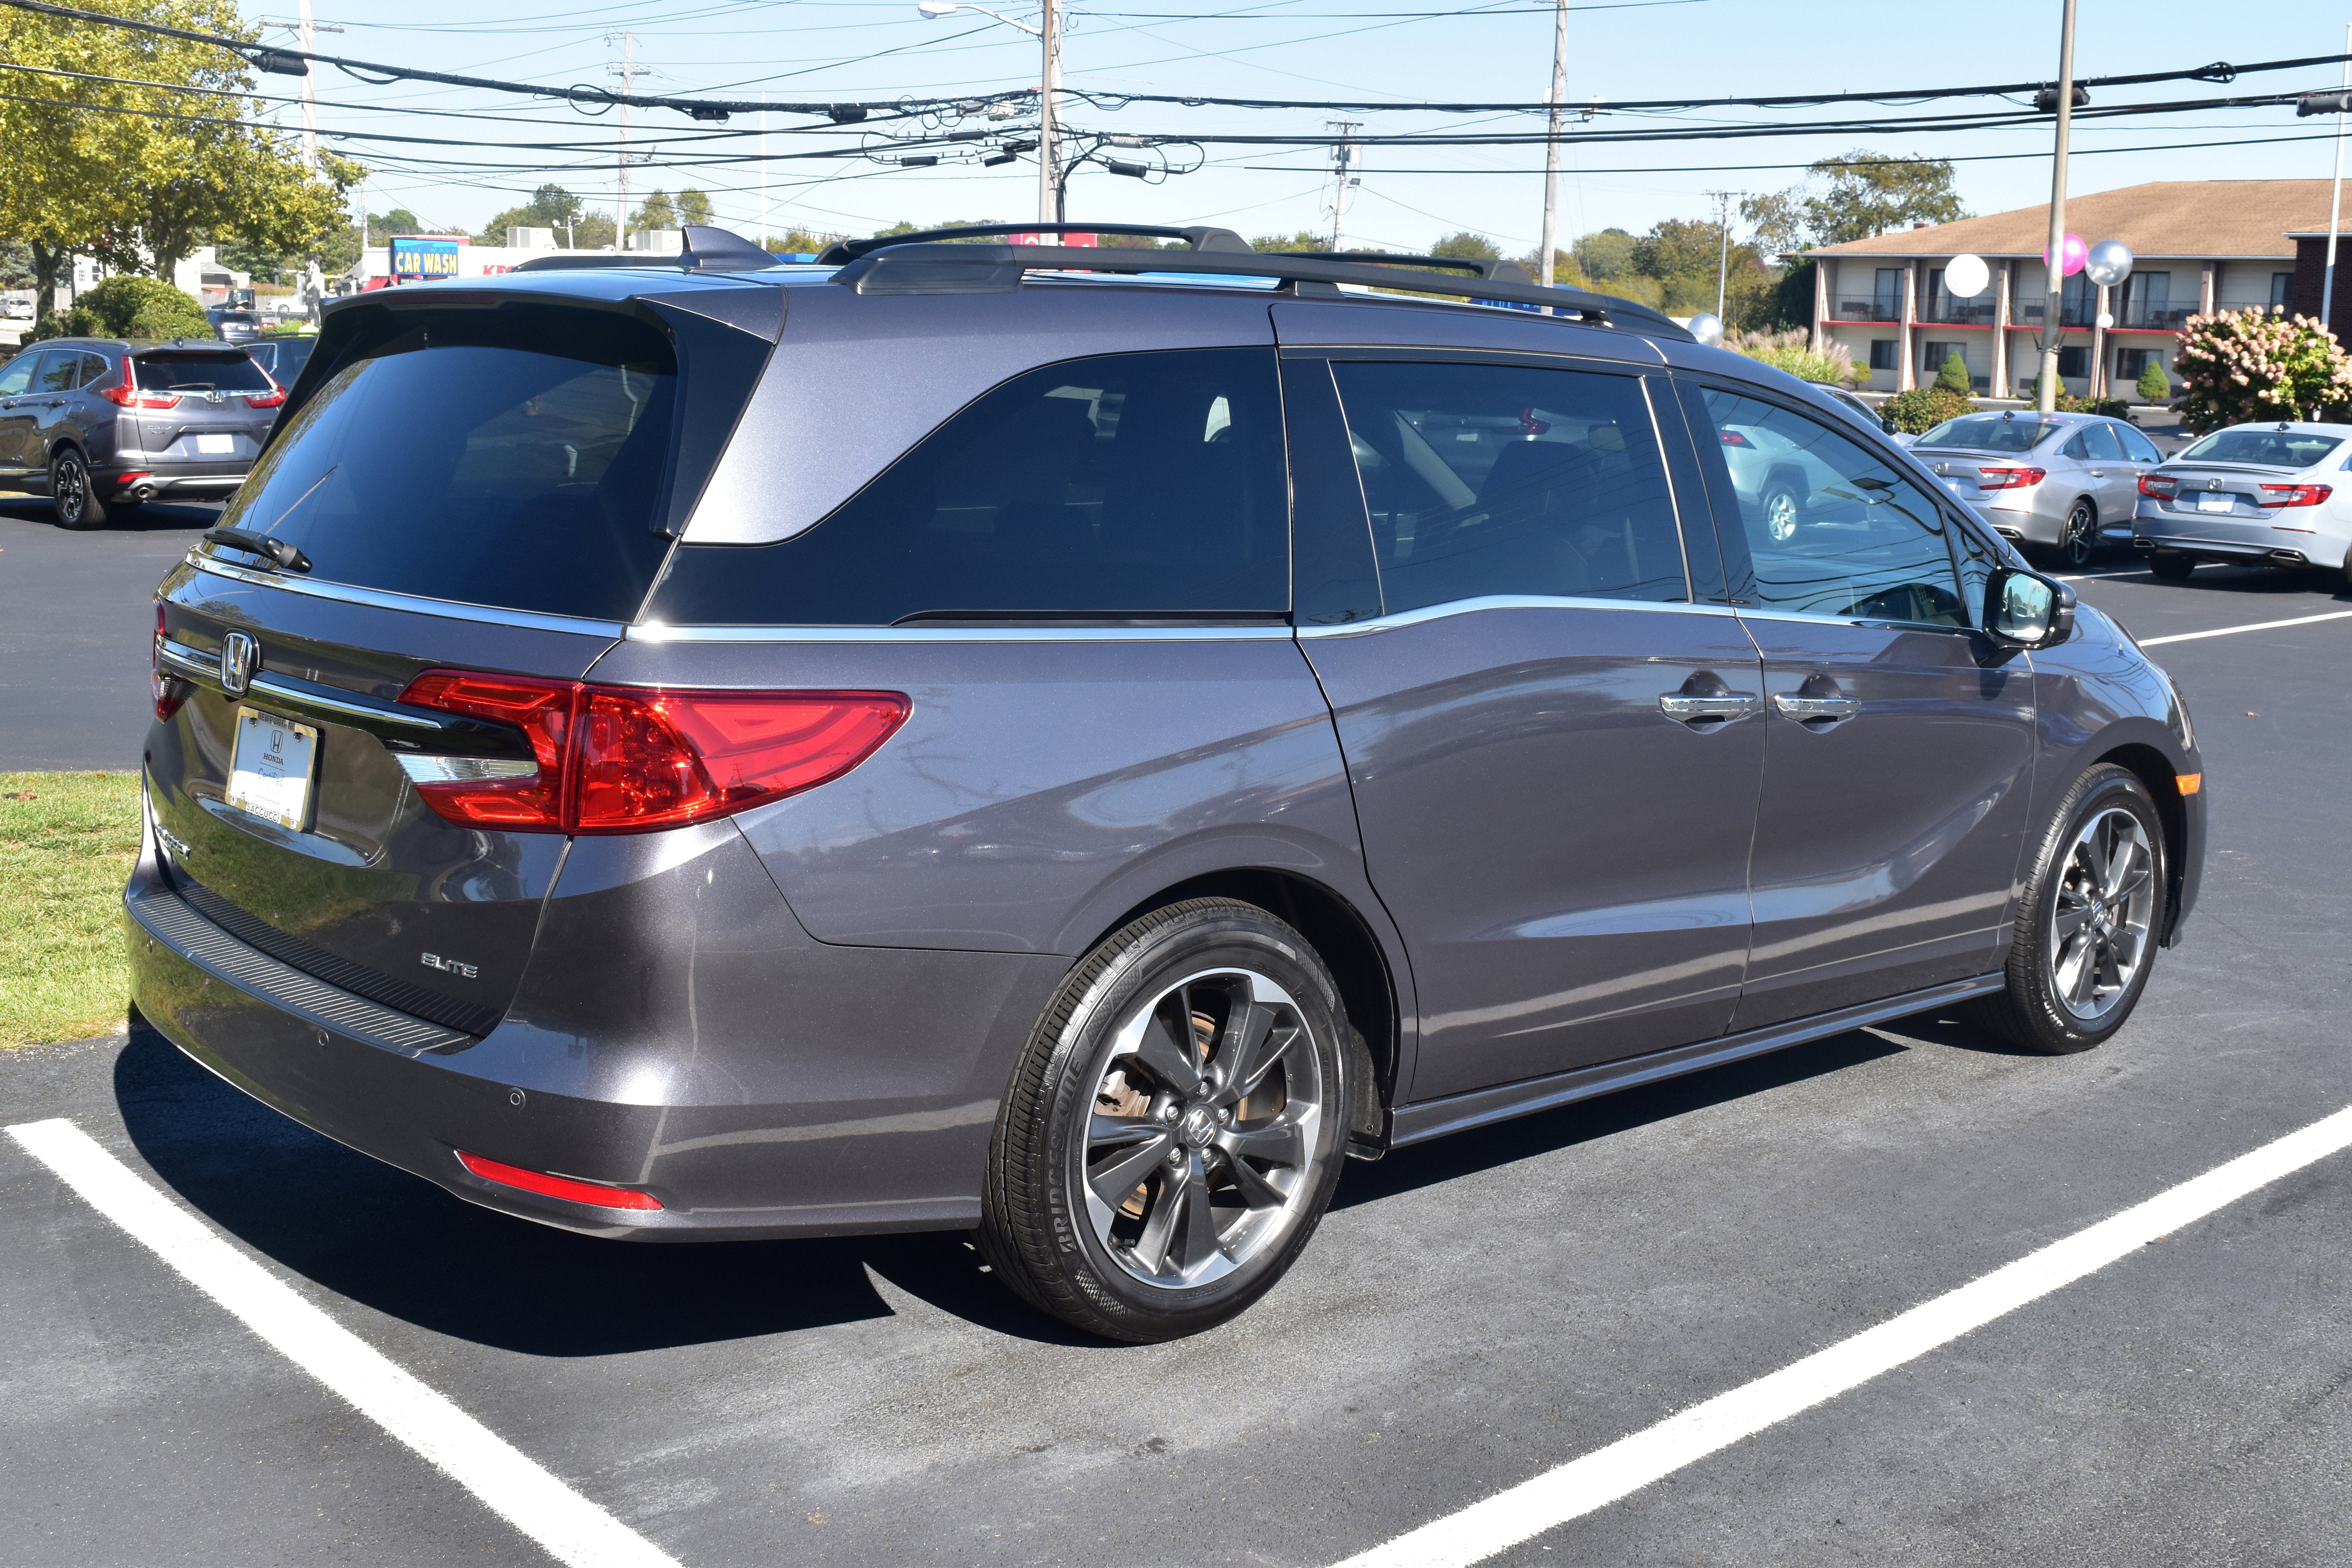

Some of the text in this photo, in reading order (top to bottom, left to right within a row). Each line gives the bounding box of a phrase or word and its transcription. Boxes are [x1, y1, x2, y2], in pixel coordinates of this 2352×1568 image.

[396, 252, 457, 274] CAR WASH
[263, 753, 283, 765] HONDA
[247, 803, 281, 822] SACCUCCI
[421, 952, 478, 978] ELITE
[1049, 1057, 1083, 1253] BRIDGESTONE
